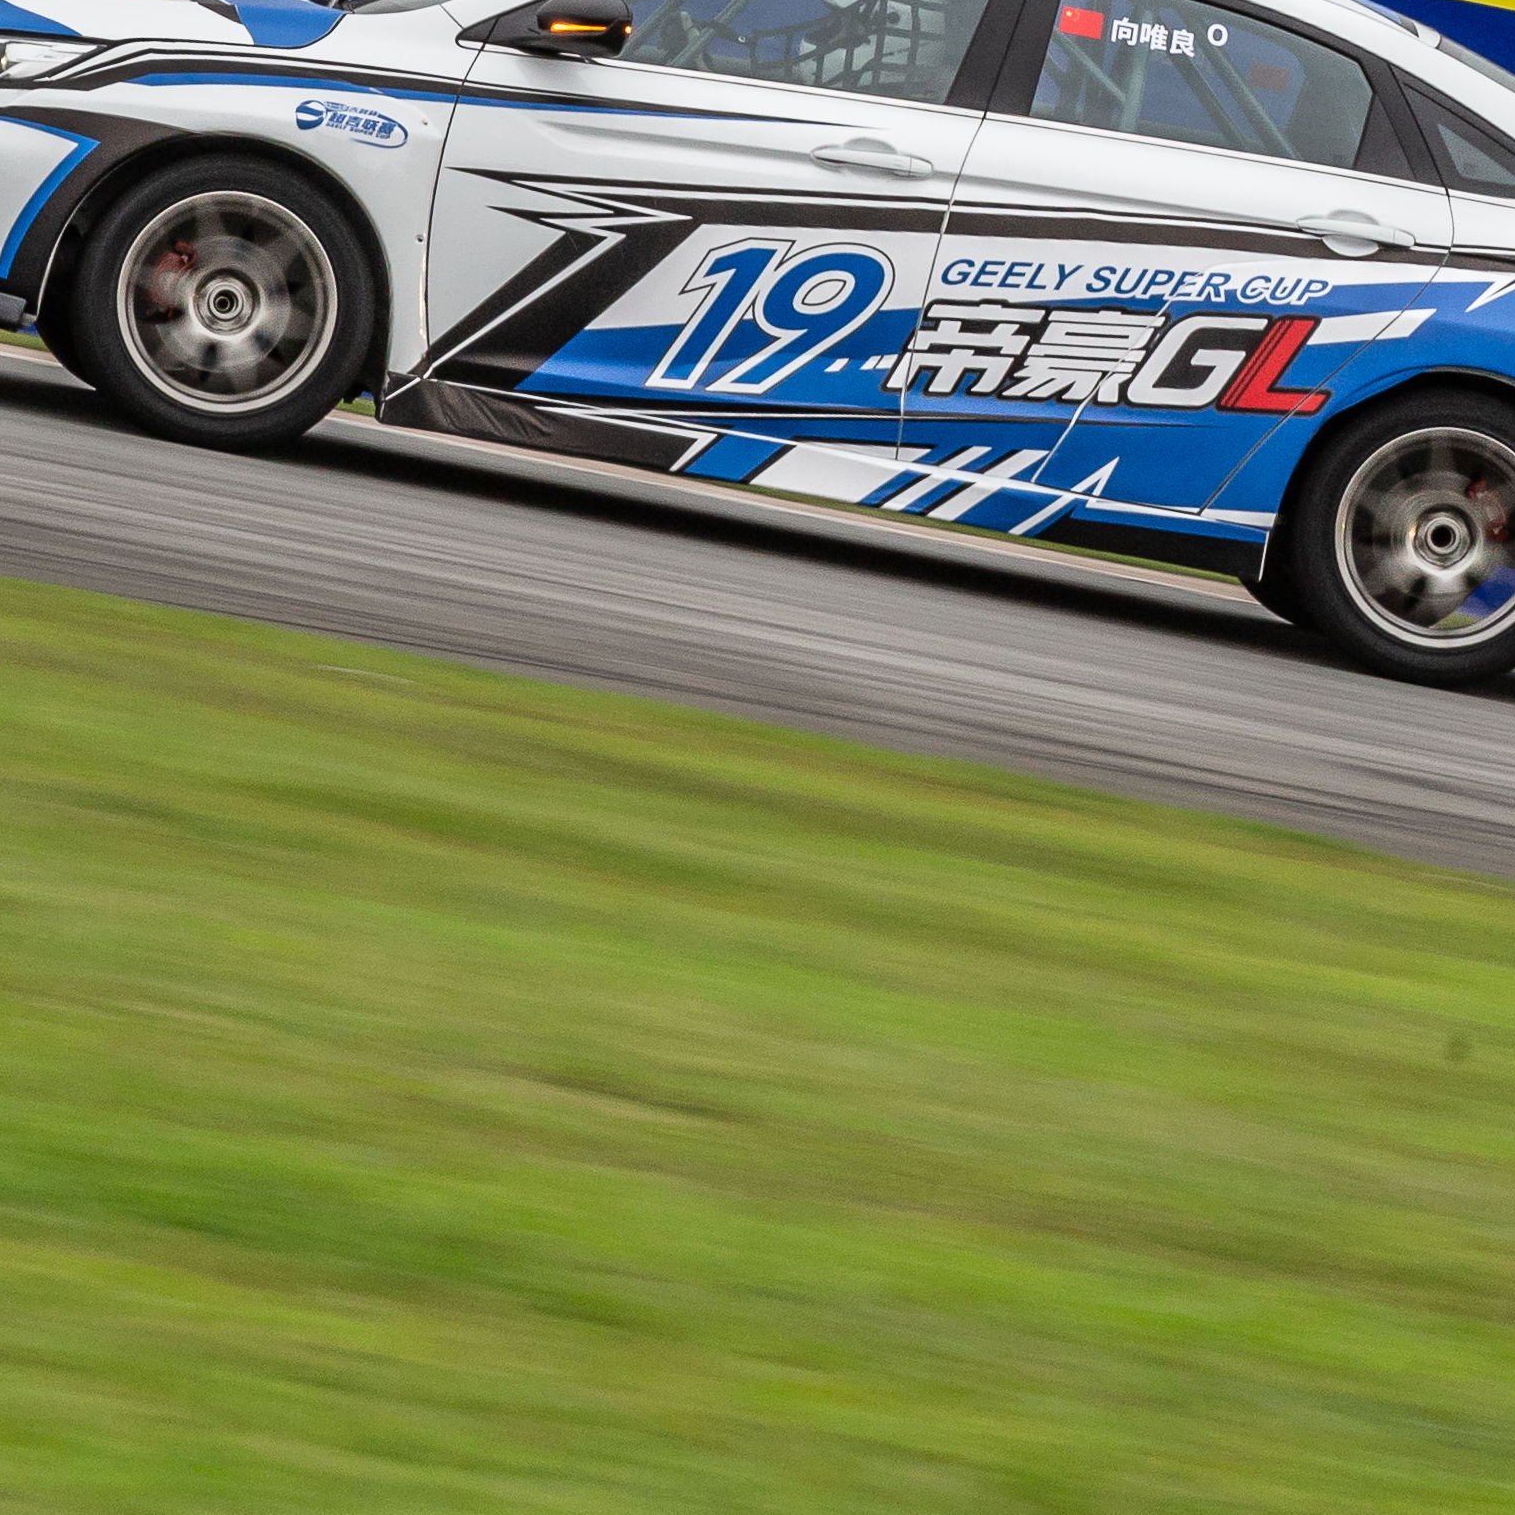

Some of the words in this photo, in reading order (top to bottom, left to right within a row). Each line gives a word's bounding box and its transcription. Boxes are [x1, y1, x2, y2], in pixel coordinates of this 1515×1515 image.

[1111, 17, 1195, 57] 向唯良
[940, 258, 1084, 289] GEELY
[1085, 265, 1232, 303] SUPER
[1235, 273, 1334, 306] CUP
[645, 238, 895, 395] 19
